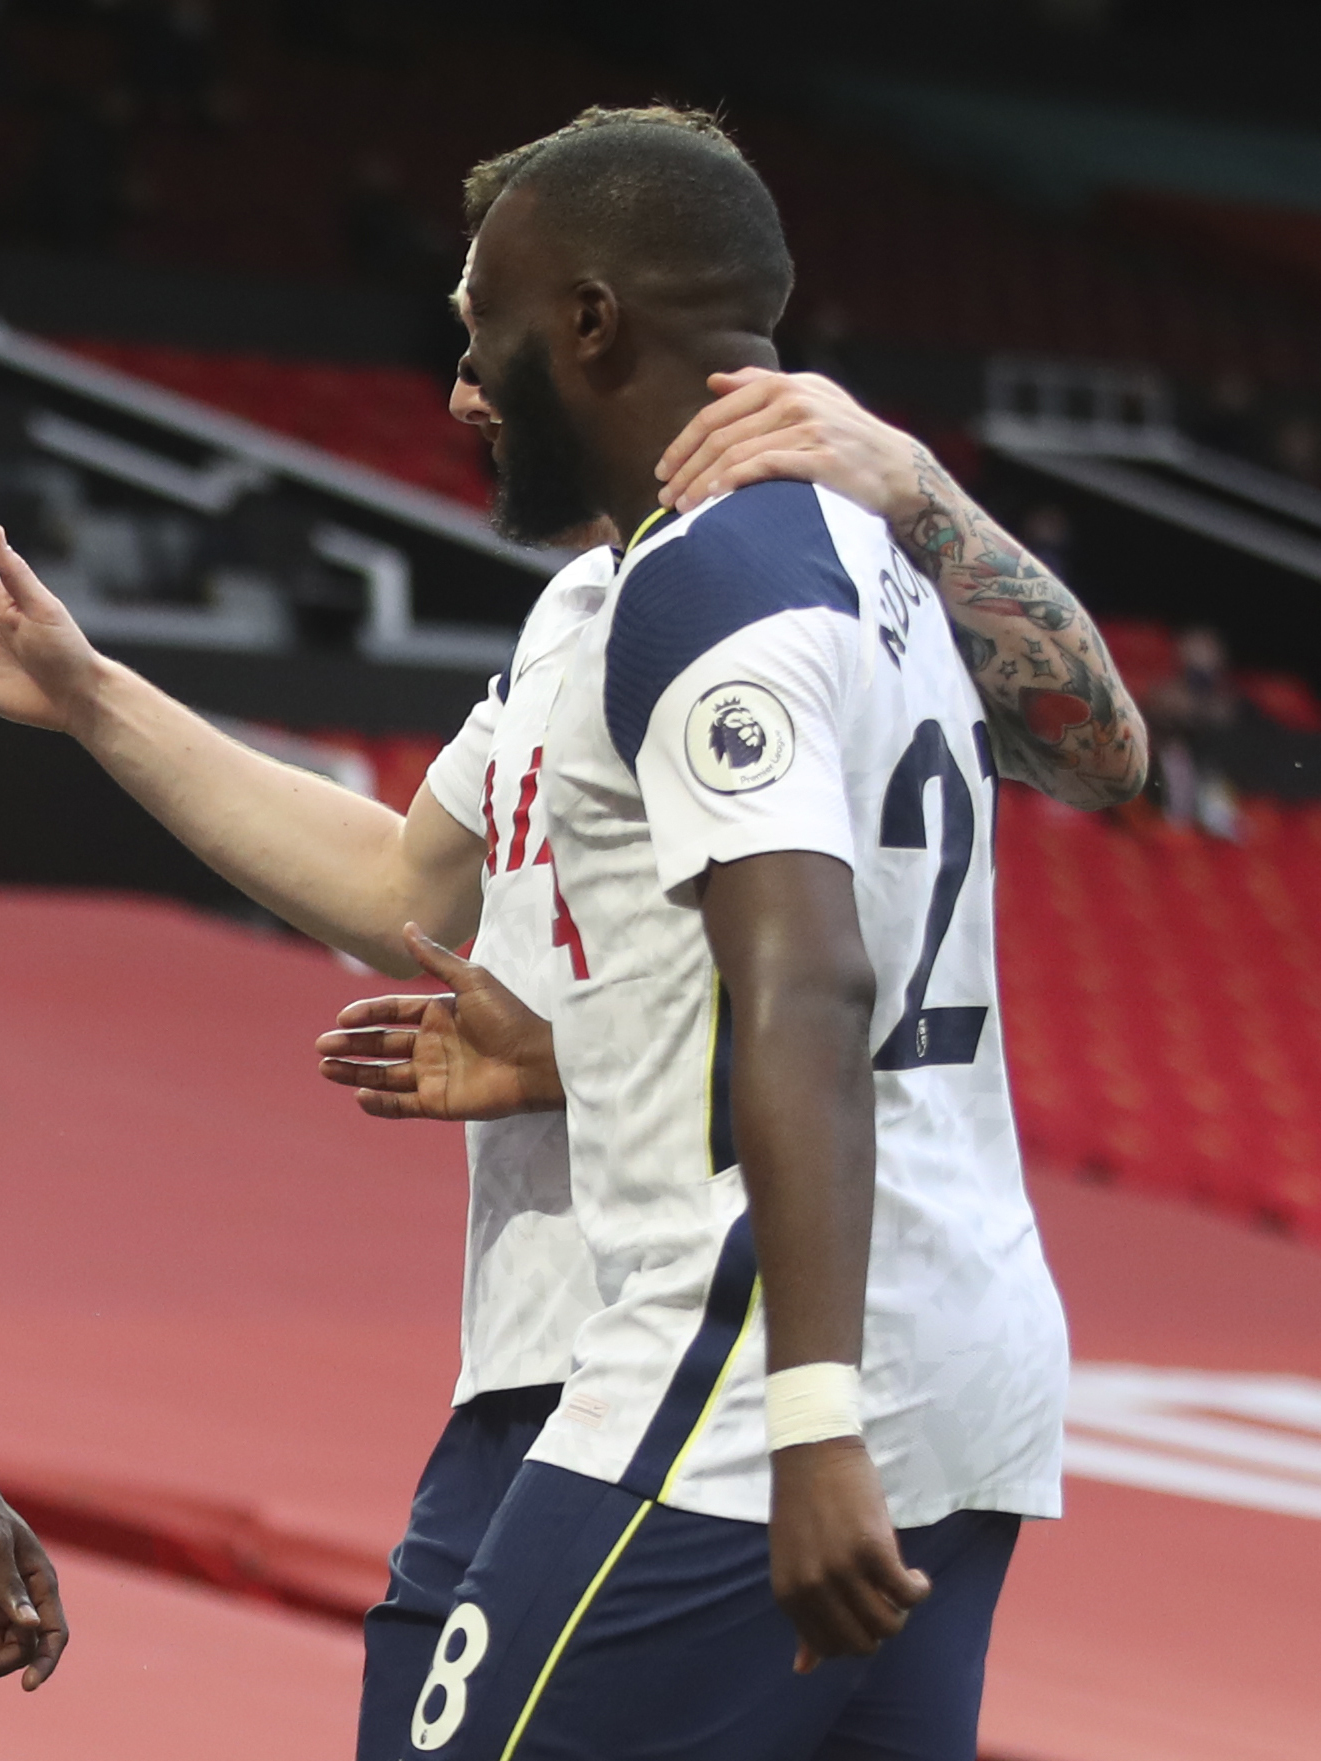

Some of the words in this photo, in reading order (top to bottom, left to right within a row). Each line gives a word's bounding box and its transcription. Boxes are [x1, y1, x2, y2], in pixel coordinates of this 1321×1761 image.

[879, 544, 929, 673] NDO
[740, 764, 774, 784] Premier
[873, 719, 999, 1071] 2
[411, 1602, 489, 1751] 8
